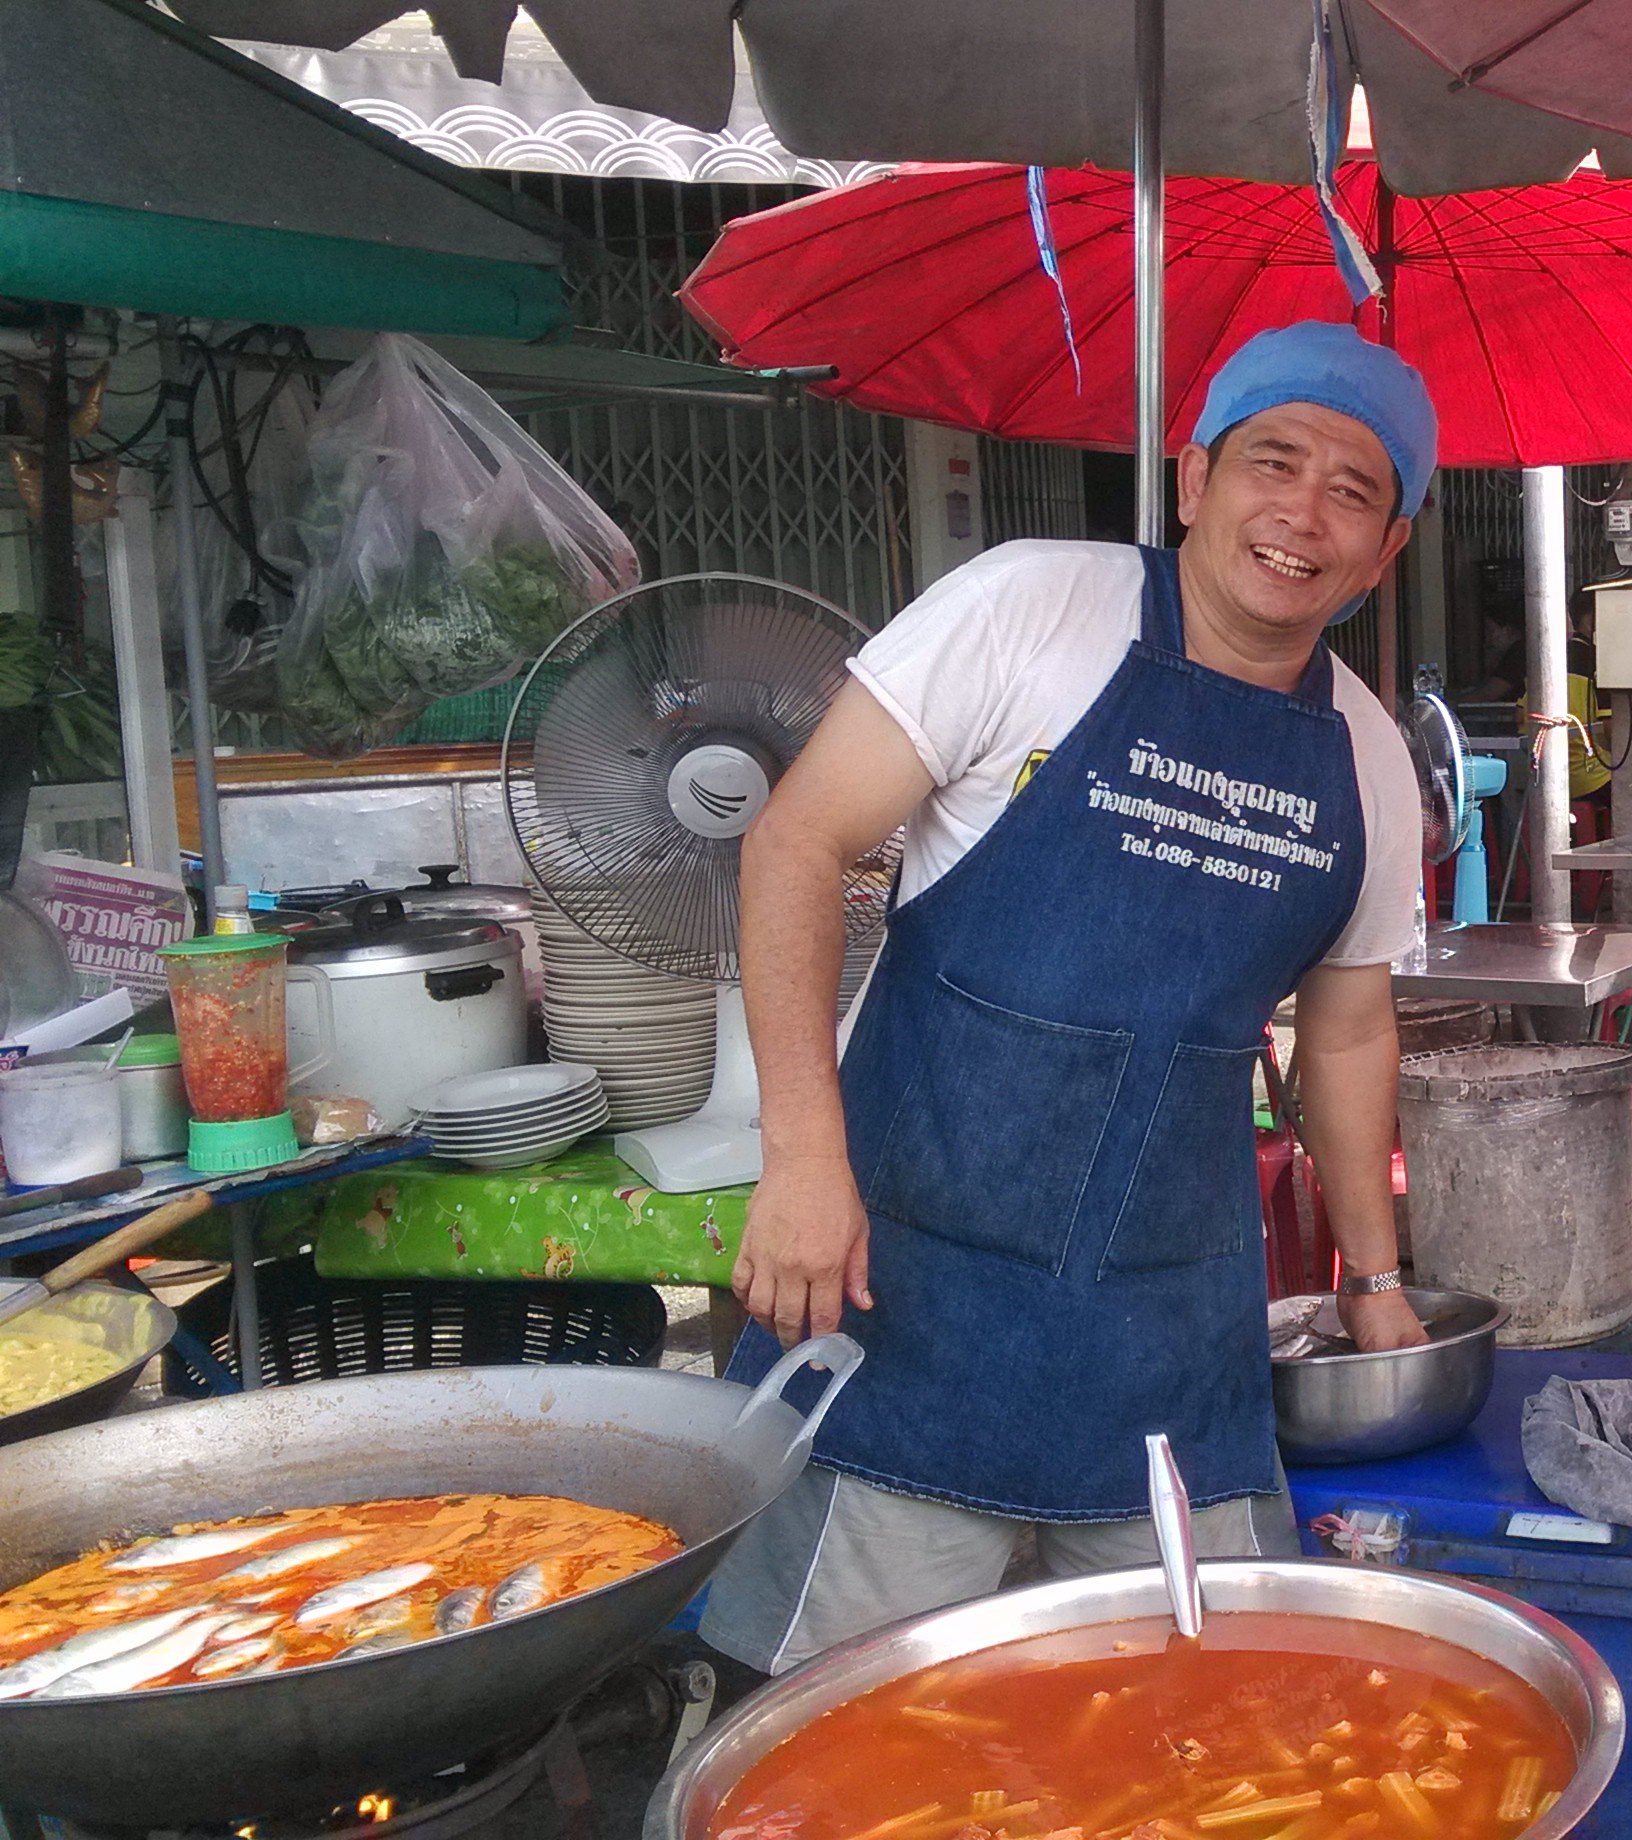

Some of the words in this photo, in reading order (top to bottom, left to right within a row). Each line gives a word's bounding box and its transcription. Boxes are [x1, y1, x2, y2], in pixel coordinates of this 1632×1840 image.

[1129, 737, 1318, 834] ข้าวแกงคุณหมู
